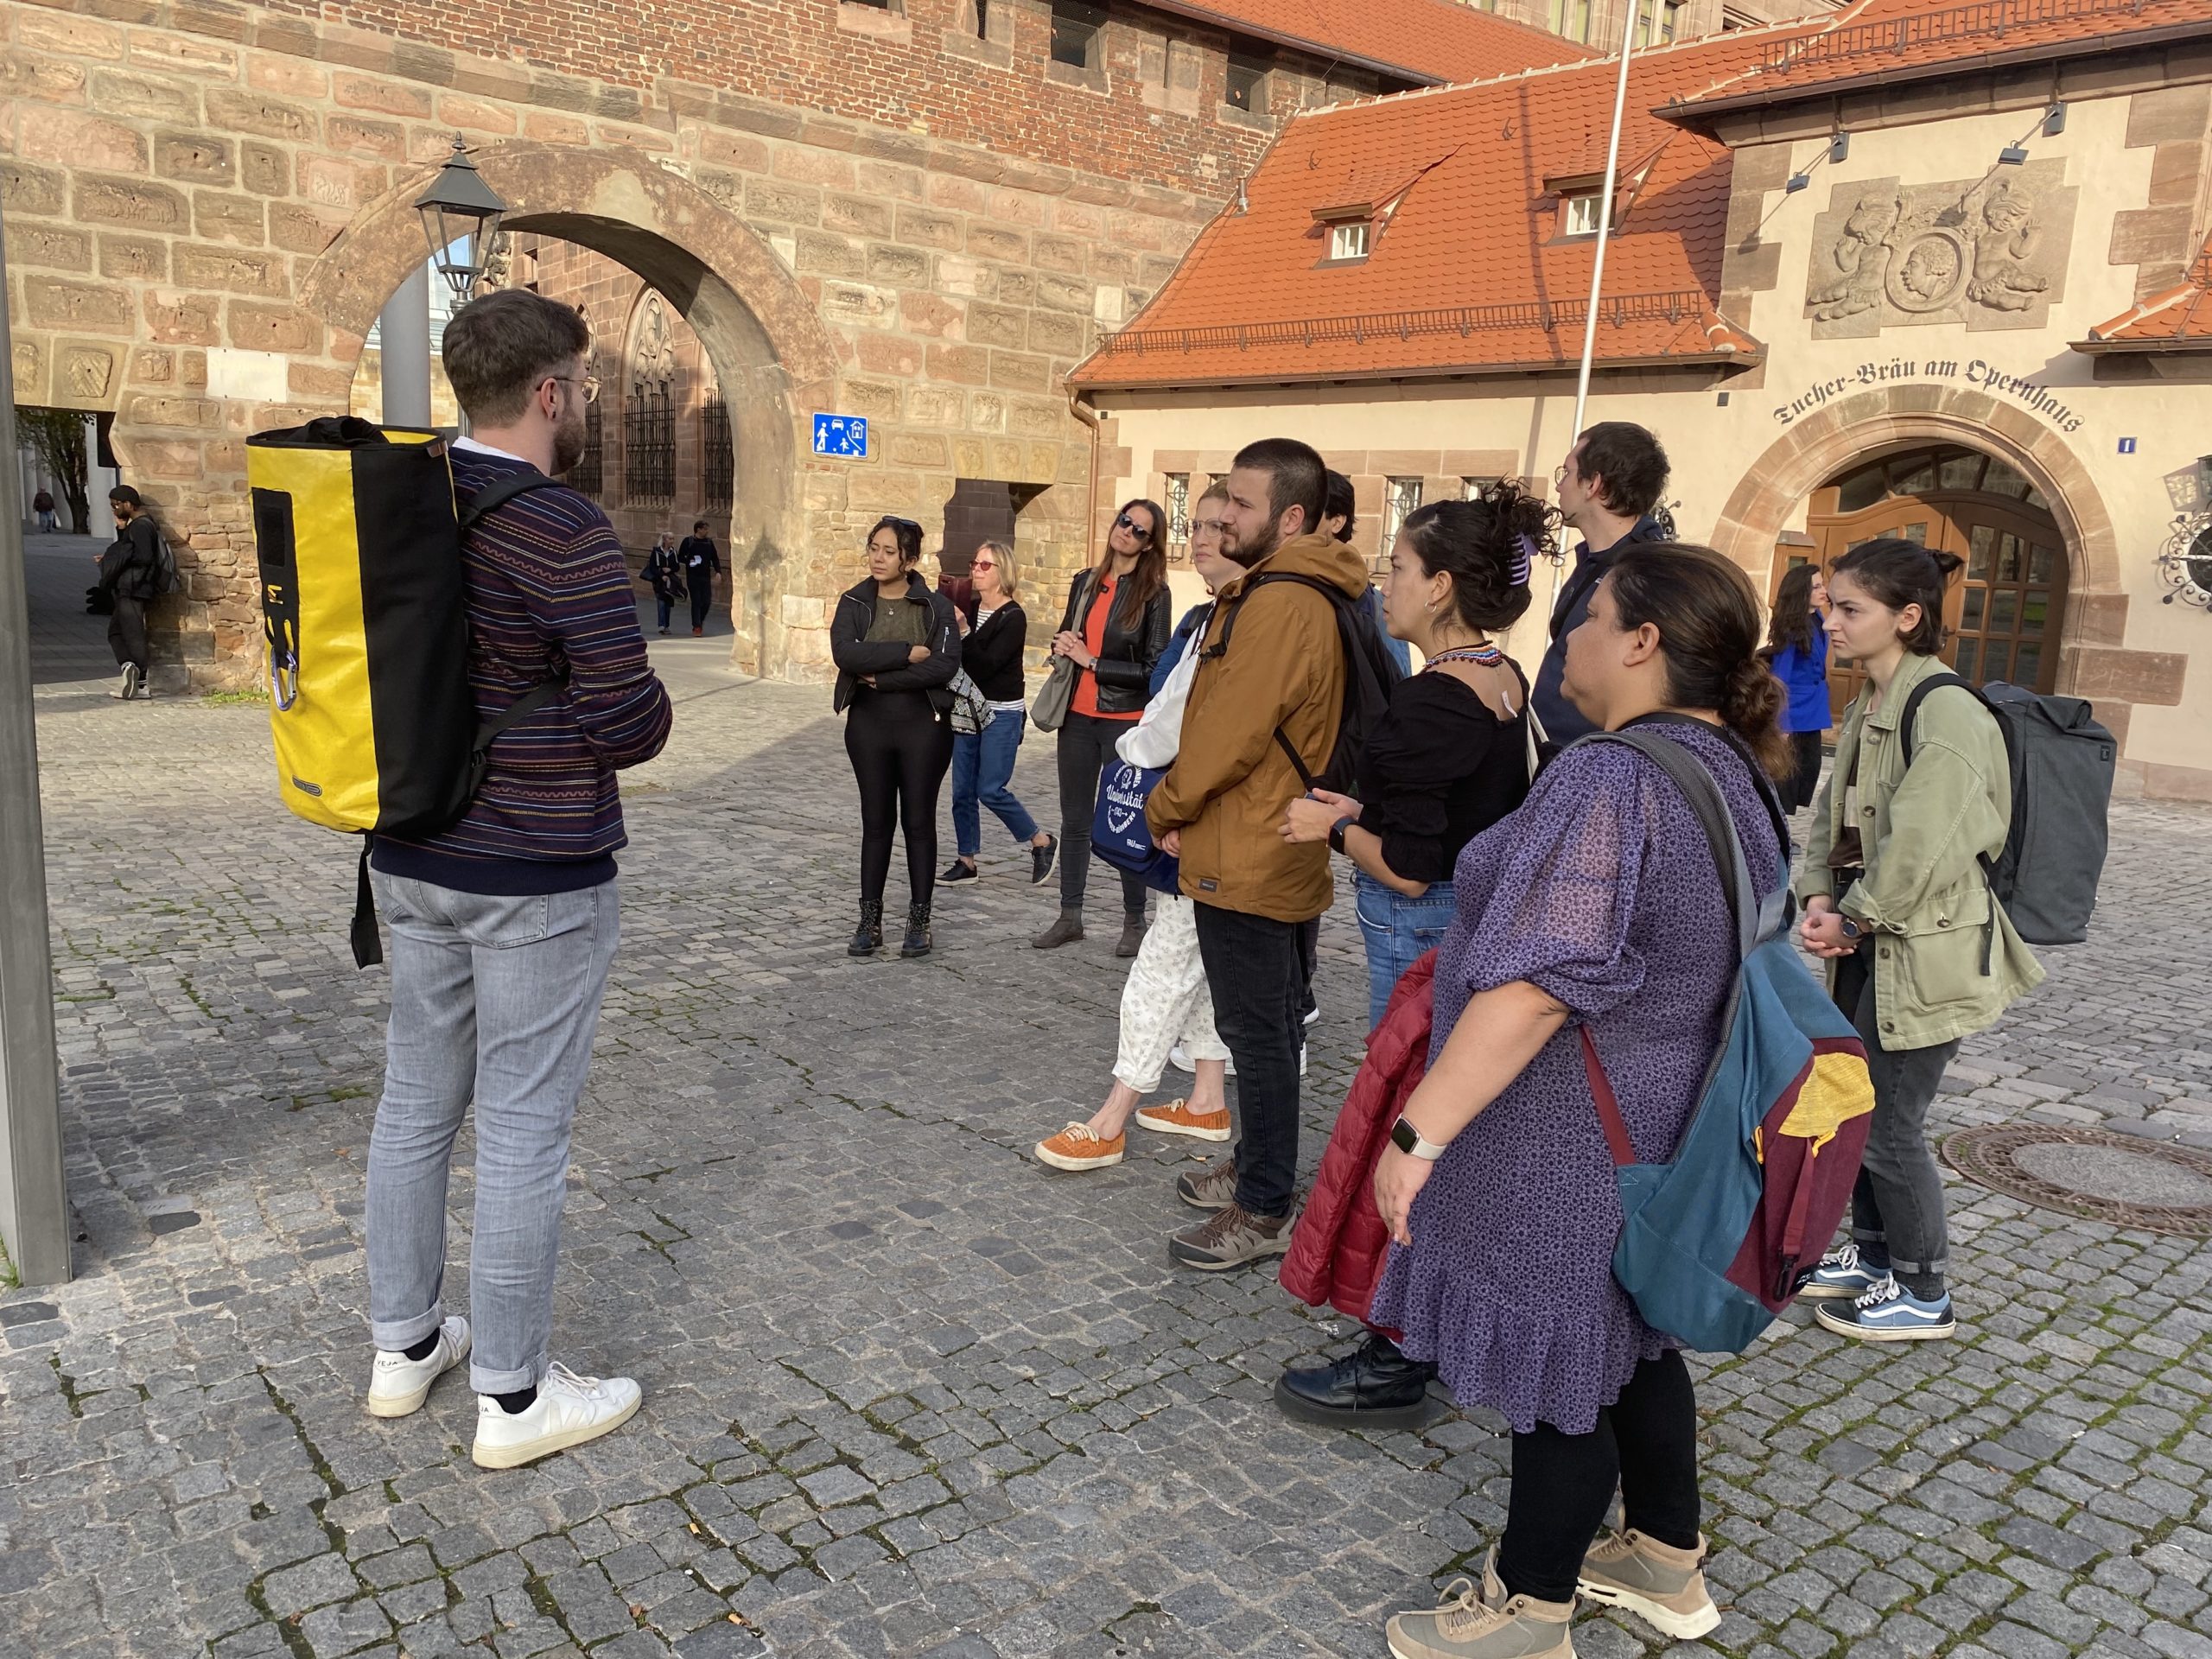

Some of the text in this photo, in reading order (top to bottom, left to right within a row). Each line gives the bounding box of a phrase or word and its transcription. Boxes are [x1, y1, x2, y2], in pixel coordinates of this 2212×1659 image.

[1773, 357, 2086, 433] Tucher-Bräu am Opernhaus
[2123, 439, 2131, 452] 1
[1106, 784, 1144, 810] Universität
